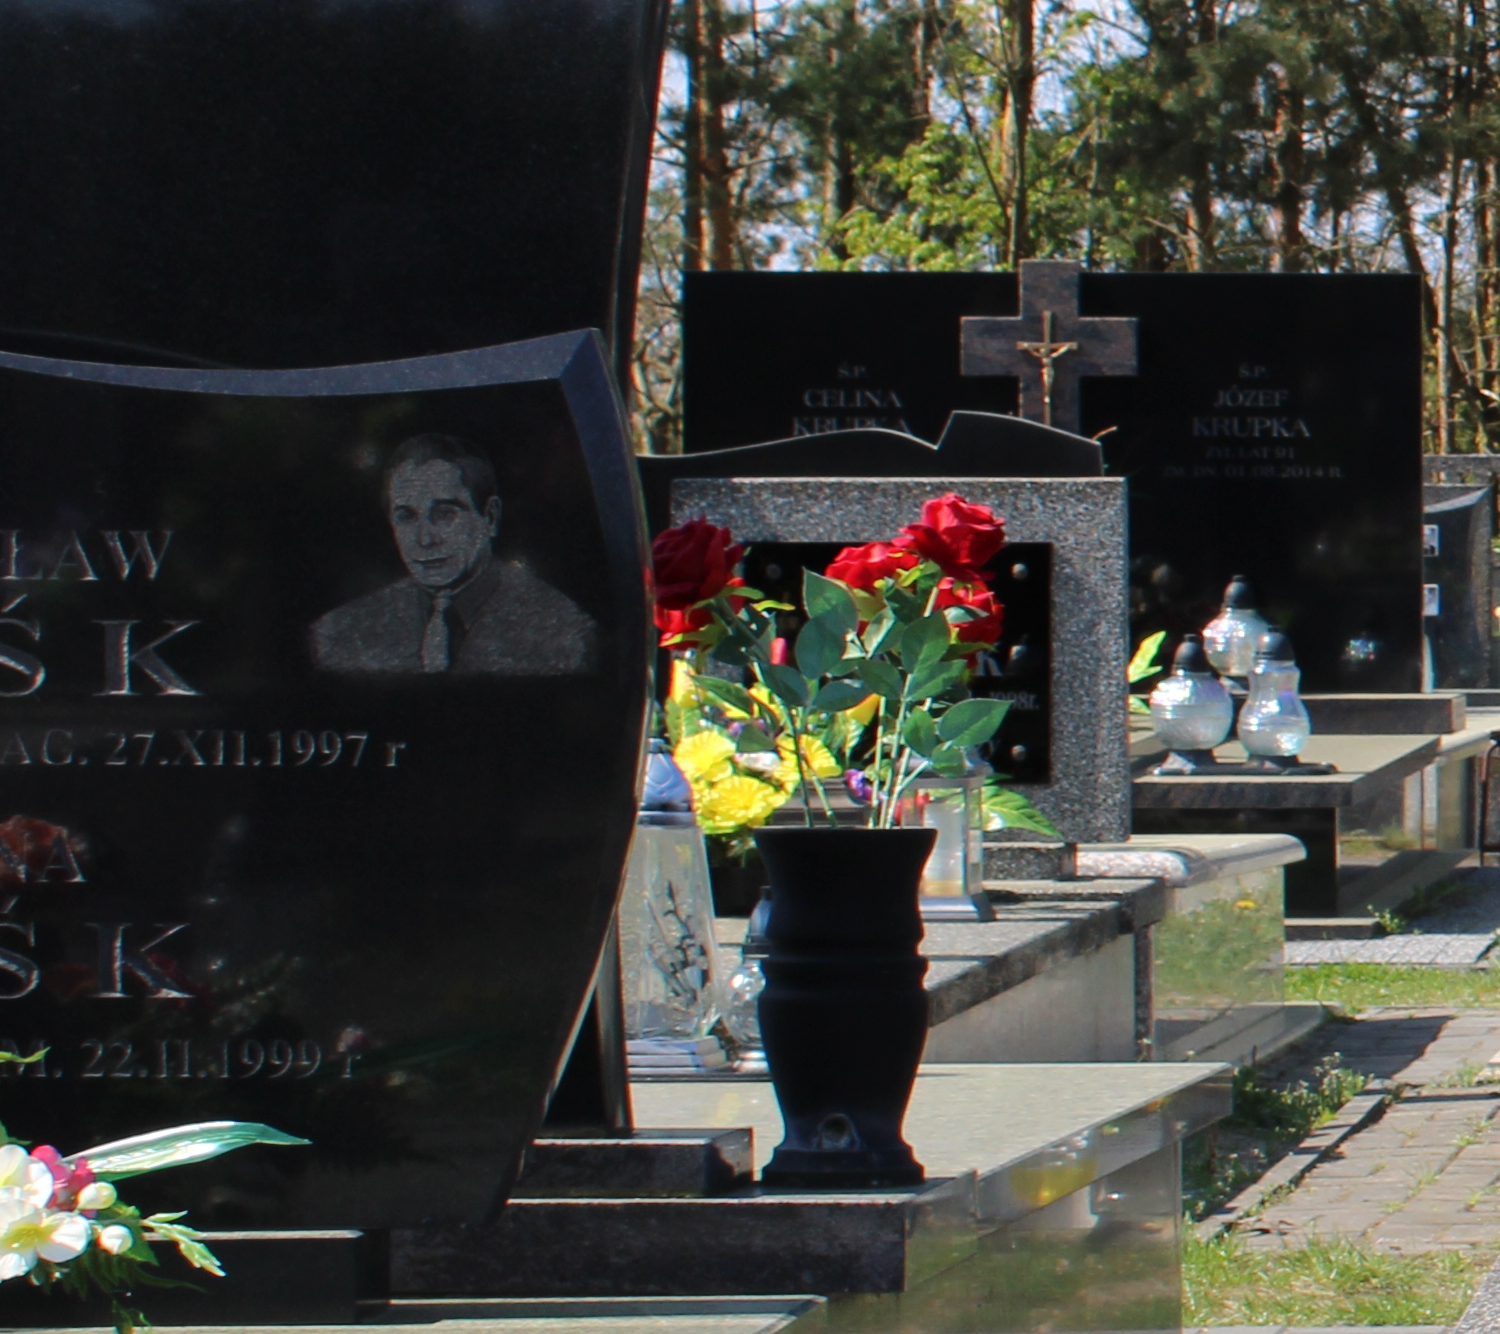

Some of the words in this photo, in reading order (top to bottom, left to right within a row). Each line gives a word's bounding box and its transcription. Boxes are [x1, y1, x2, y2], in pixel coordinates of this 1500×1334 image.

[802, 388, 902, 408] CELINA
[1213, 384, 1290, 408] JÓZEF
[1191, 416, 1311, 439] KRUPKA
[384, 741, 407, 767] r
